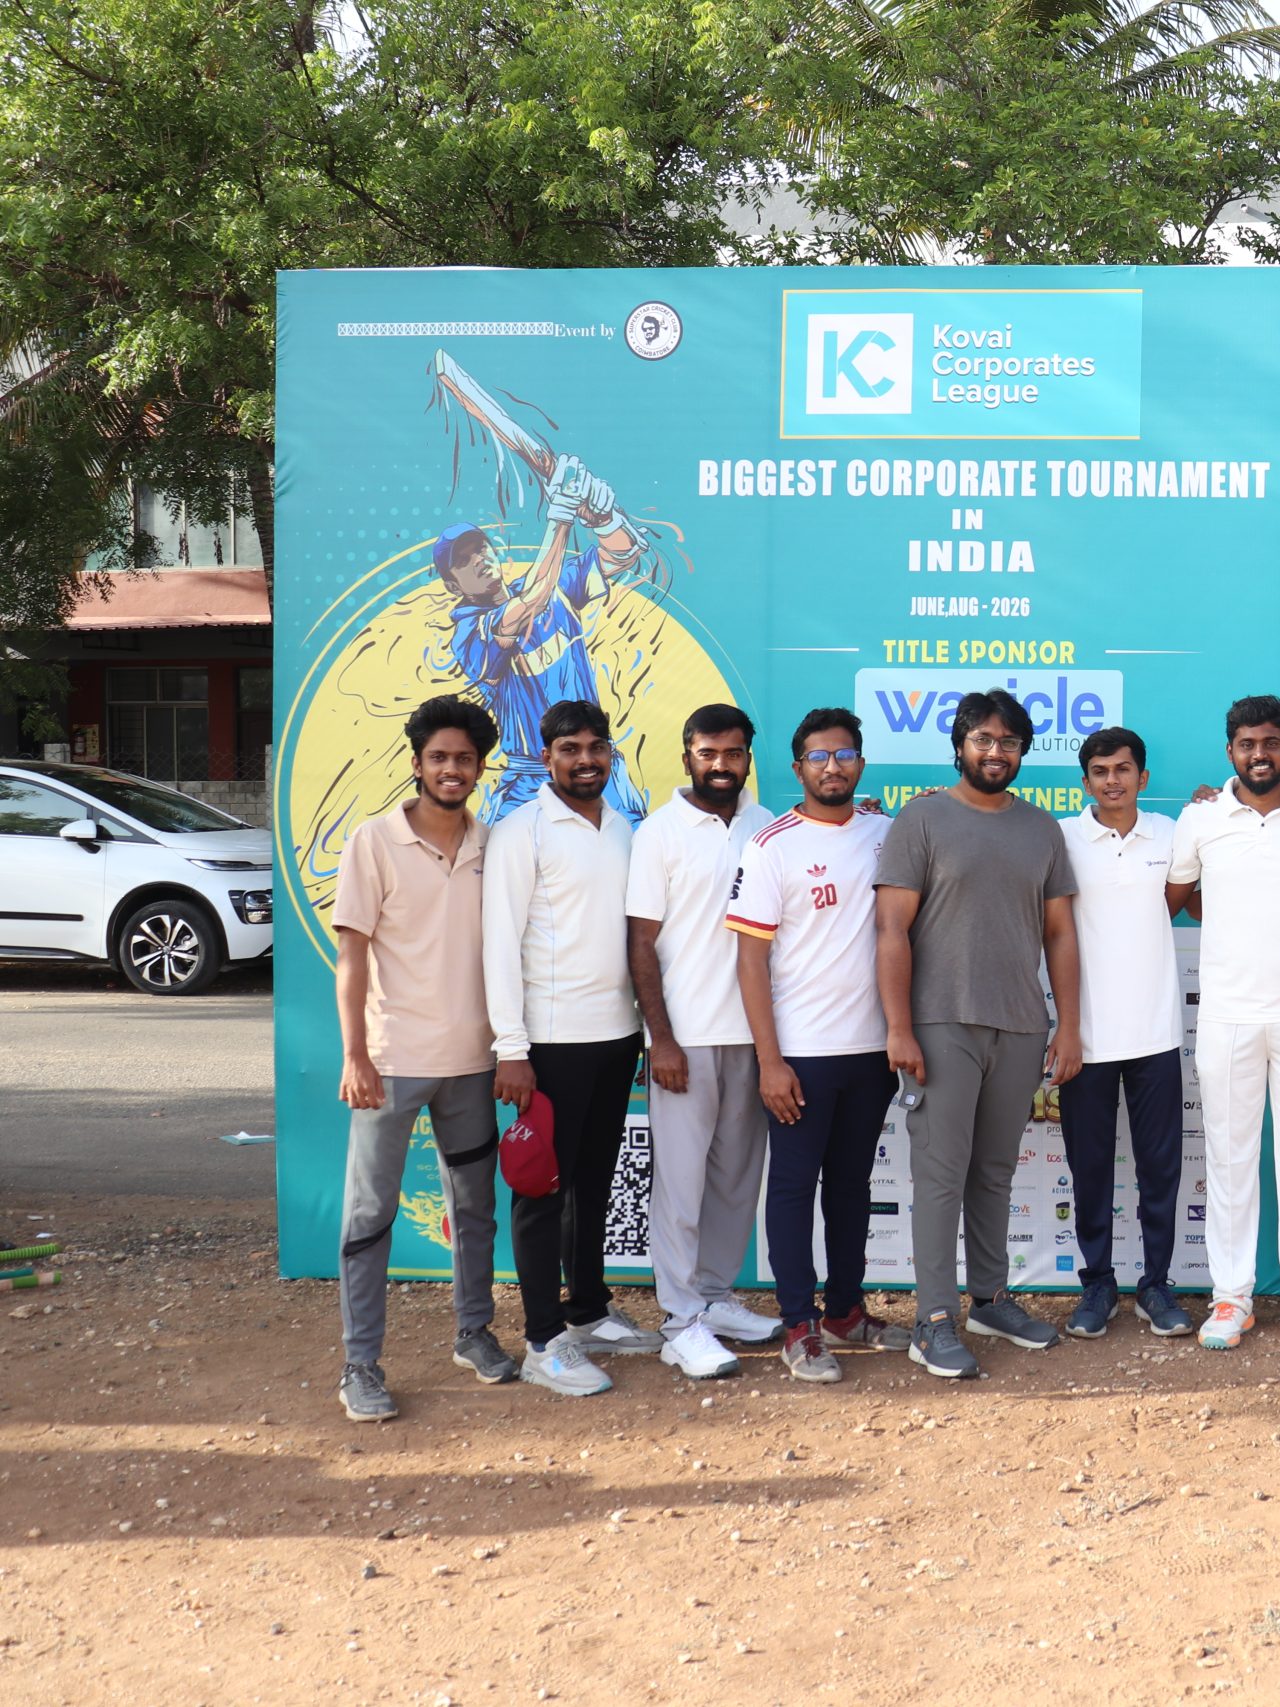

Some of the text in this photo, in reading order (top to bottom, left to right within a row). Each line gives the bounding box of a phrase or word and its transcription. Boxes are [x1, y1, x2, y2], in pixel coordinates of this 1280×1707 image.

[651, 306, 672, 317] CRICKET
[554, 324, 616, 340] Event by
[933, 323, 1012, 349] Kovai
[932, 352, 1095, 380] Corporates
[932, 379, 1038, 408] League
[699, 459, 1271, 498] BIGGEST CORPORATE TOURNAMENT
[952, 509, 983, 530] IN
[909, 541, 1035, 572] INDIA
[910, 597, 979, 619] JUNE,AUG
[991, 597, 1029, 617] 2026
[884, 639, 1075, 664] TITLE SPONSOR
[811, 883, 838, 910] 20
